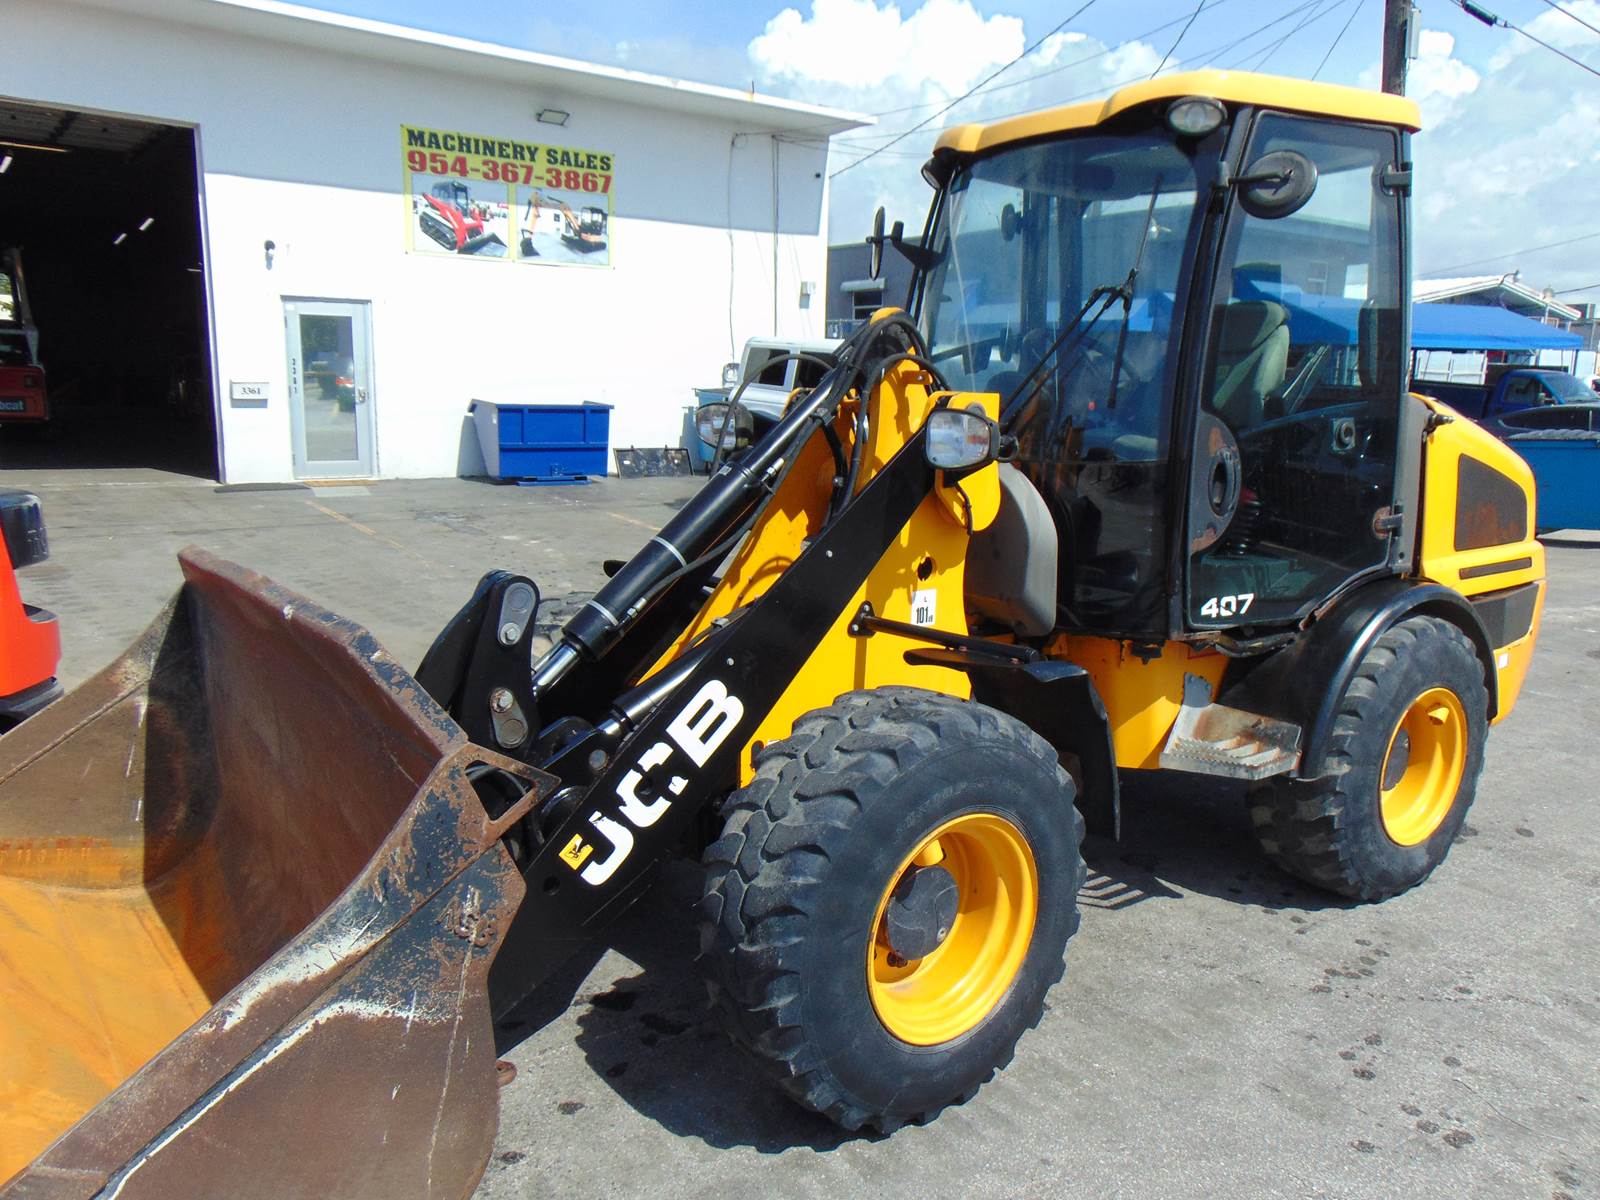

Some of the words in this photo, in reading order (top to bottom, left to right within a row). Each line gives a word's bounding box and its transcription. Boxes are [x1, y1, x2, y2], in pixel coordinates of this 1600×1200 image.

[406, 129, 539, 163] MACHINERY
[546, 148, 611, 171] SALES
[407, 150, 613, 194] 954-367-3867
[241, 386, 261, 396] 3361
[1200, 593, 1255, 618] 407
[580, 679, 745, 886] JCB
